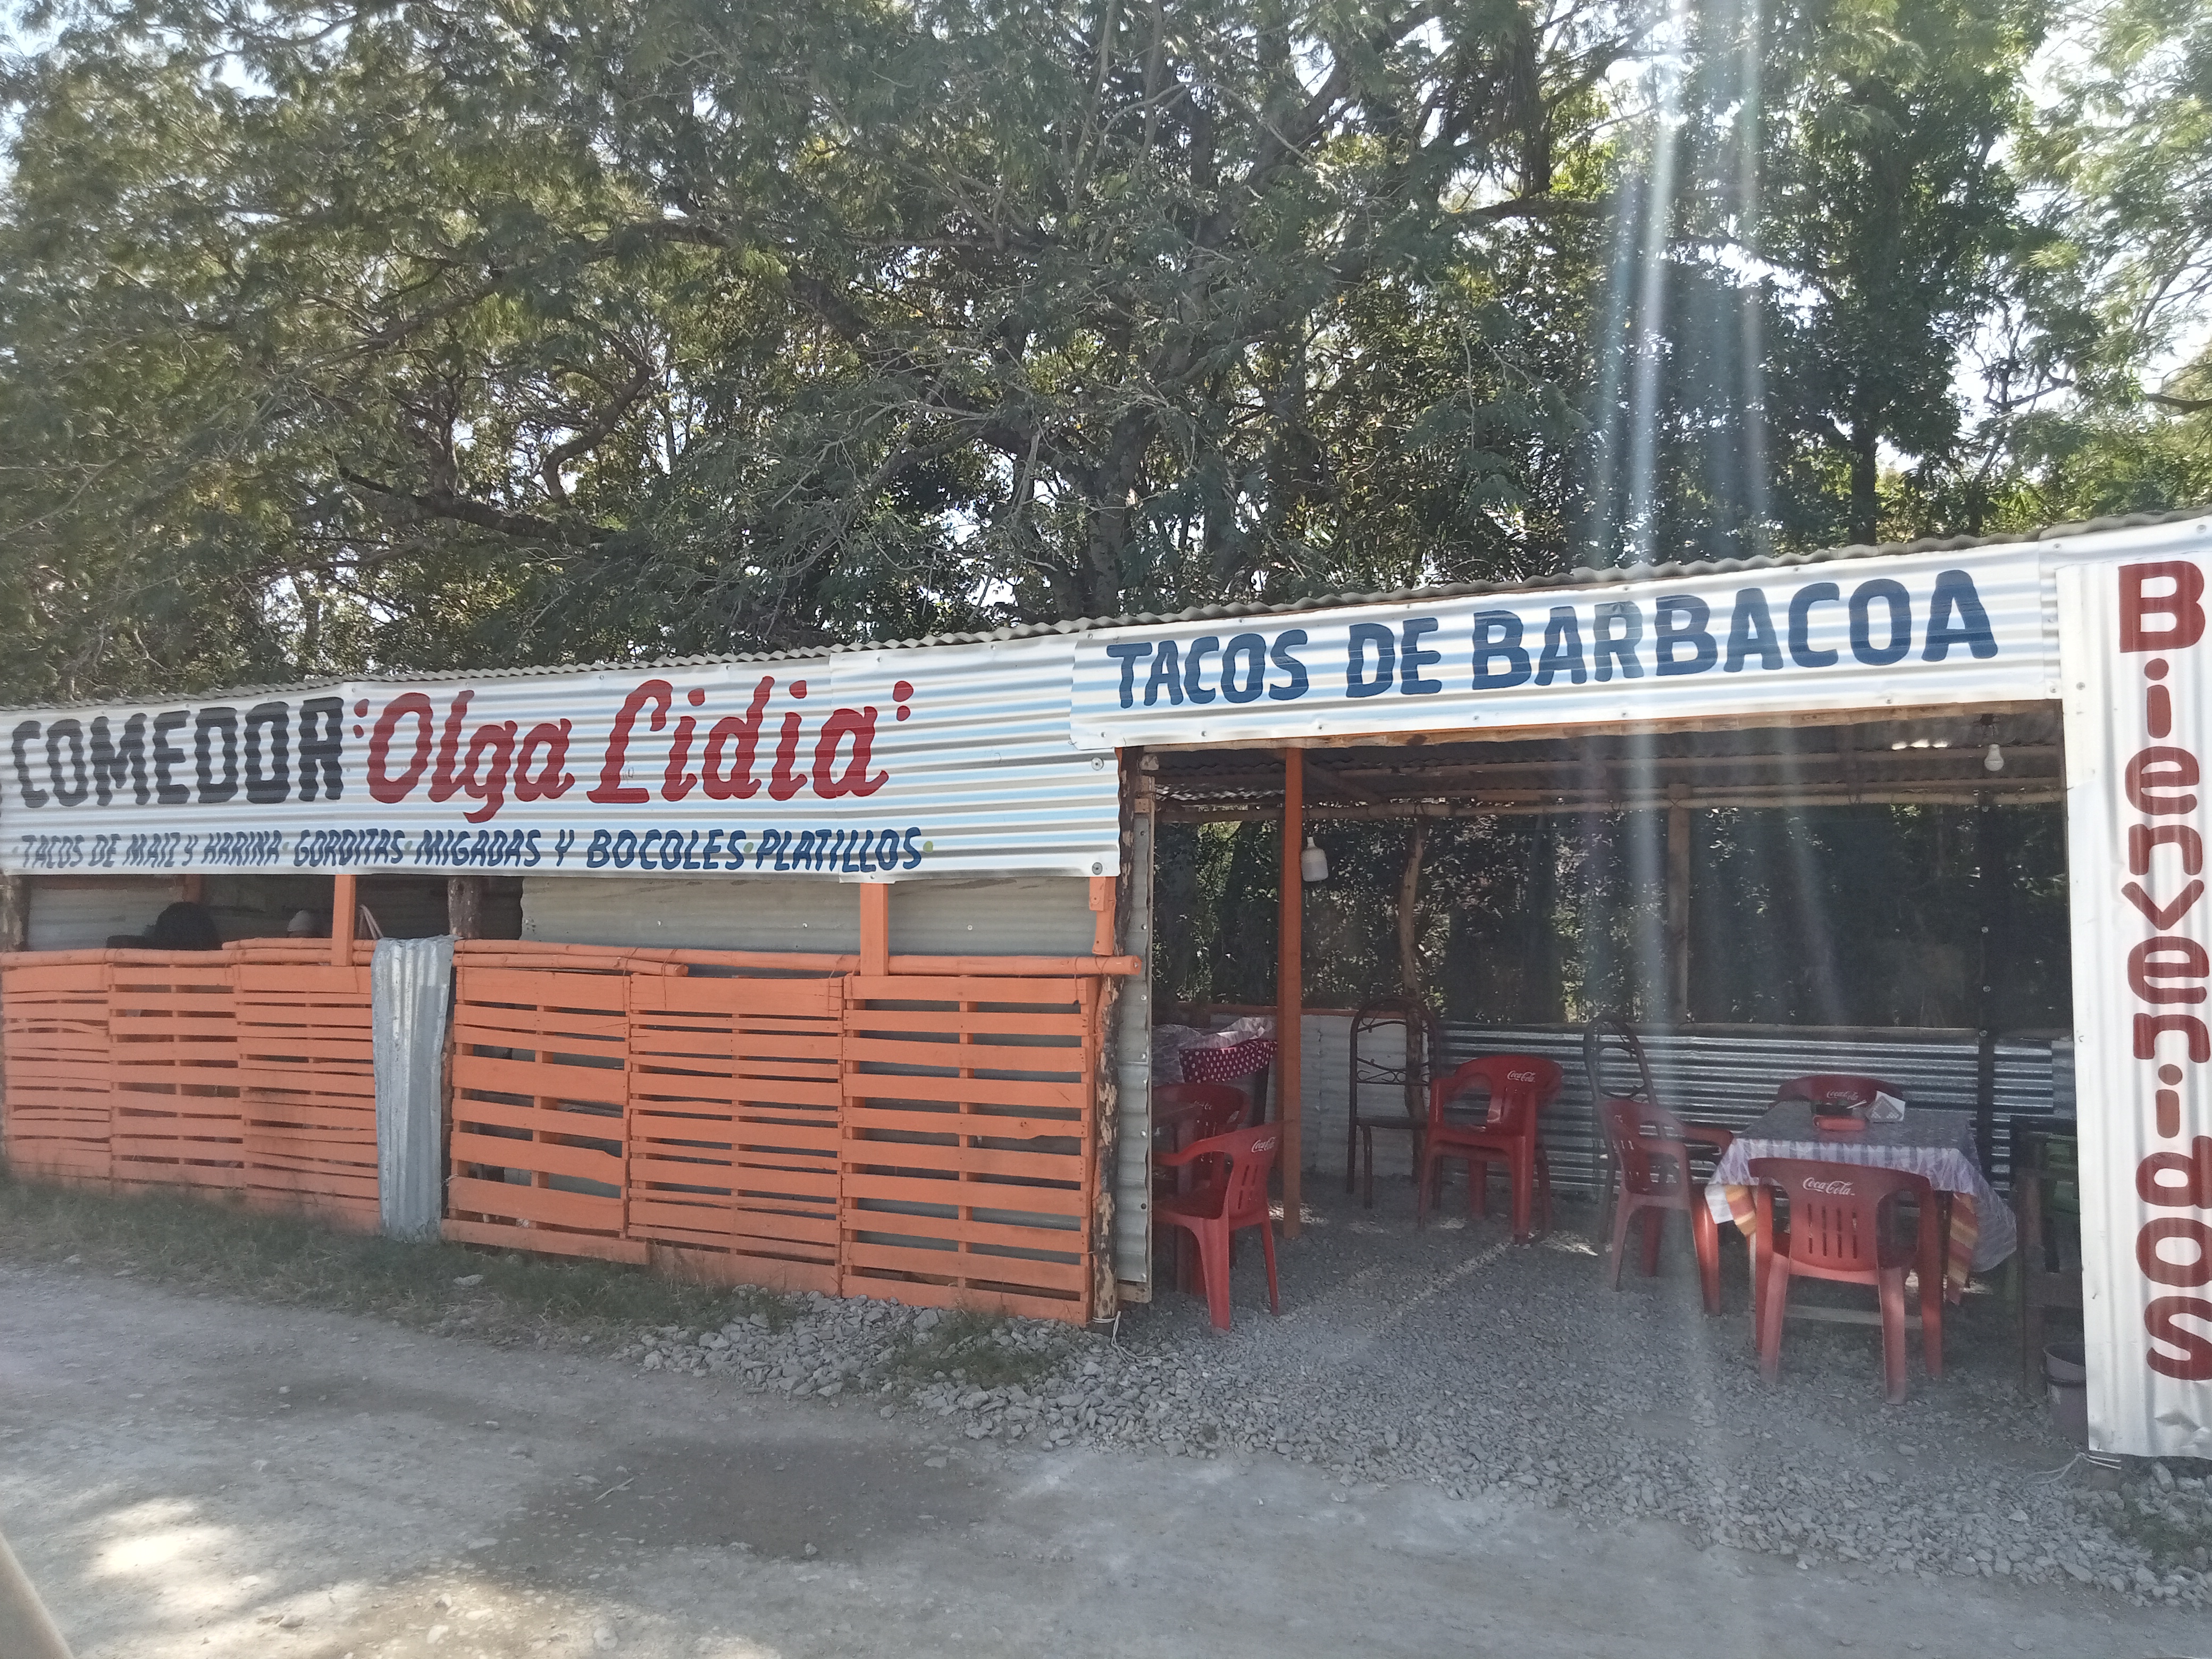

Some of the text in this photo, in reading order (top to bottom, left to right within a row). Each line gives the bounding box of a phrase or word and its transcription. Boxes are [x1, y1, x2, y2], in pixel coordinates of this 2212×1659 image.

[1107, 569, 1998, 709] TACOS DE BARBACOA
[11, 696, 343, 808] COMEDOR
[22, 834, 86, 868] TACOS
[88, 833, 122, 868] DE
[122, 832, 180, 868] MAIZ
[200, 831, 281, 867] HARINA
[293, 828, 405, 868] GORDITAS
[414, 830, 541, 868] MIGADAS
[586, 828, 747, 870] BOCOLES
[755, 827, 922, 873] PLATILLOS
[2118, 560, 2212, 1381] Bienvenidos
